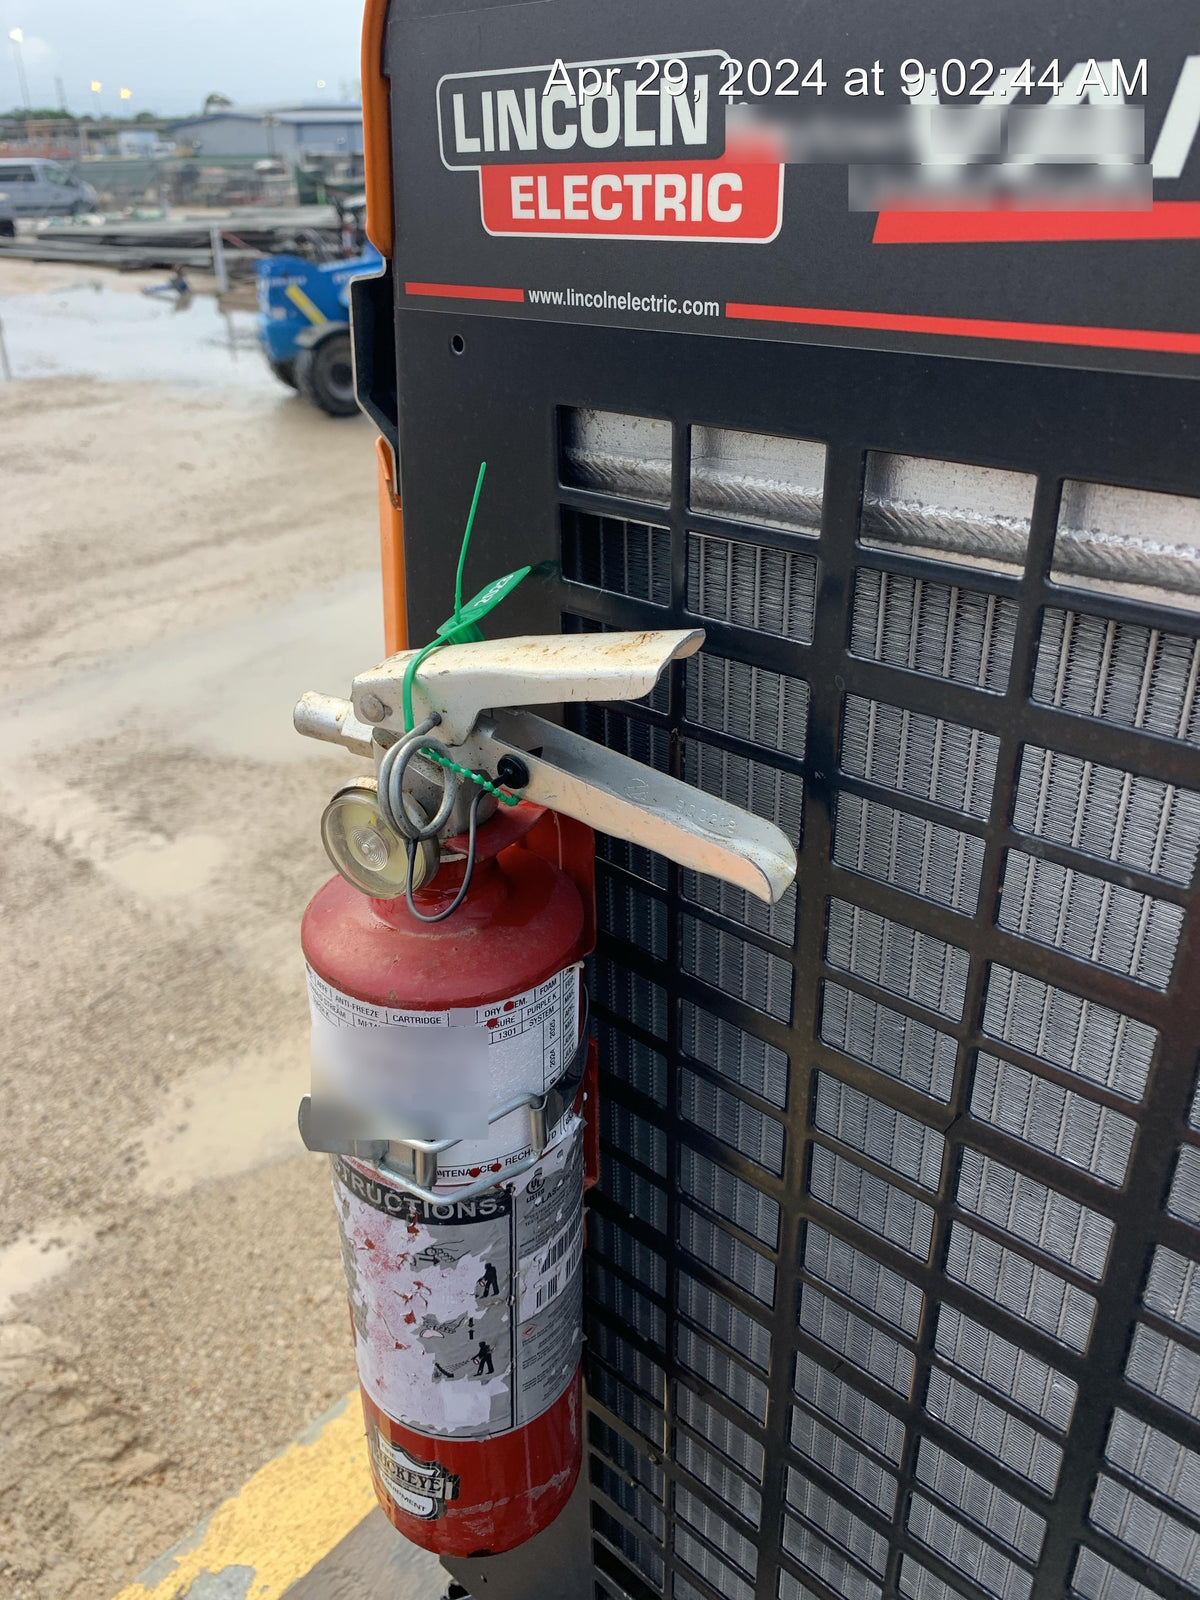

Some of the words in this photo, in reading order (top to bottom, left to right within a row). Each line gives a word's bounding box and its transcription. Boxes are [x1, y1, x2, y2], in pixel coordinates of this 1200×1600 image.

[452, 73, 709, 153] LINCOLN
[510, 172, 743, 223] ELECTRIC
[527, 288, 720, 318] www.lincolnelectric.com
[392, 1013, 442, 1025] CARTRIDGE
[484, 1006, 502, 1018] DRY
[539, 978, 557, 996] FOAM
[526, 997, 552, 1016] PURPLE
[499, 1027, 517, 1040] 1301
[529, 1005, 555, 1027] SYSTEM
